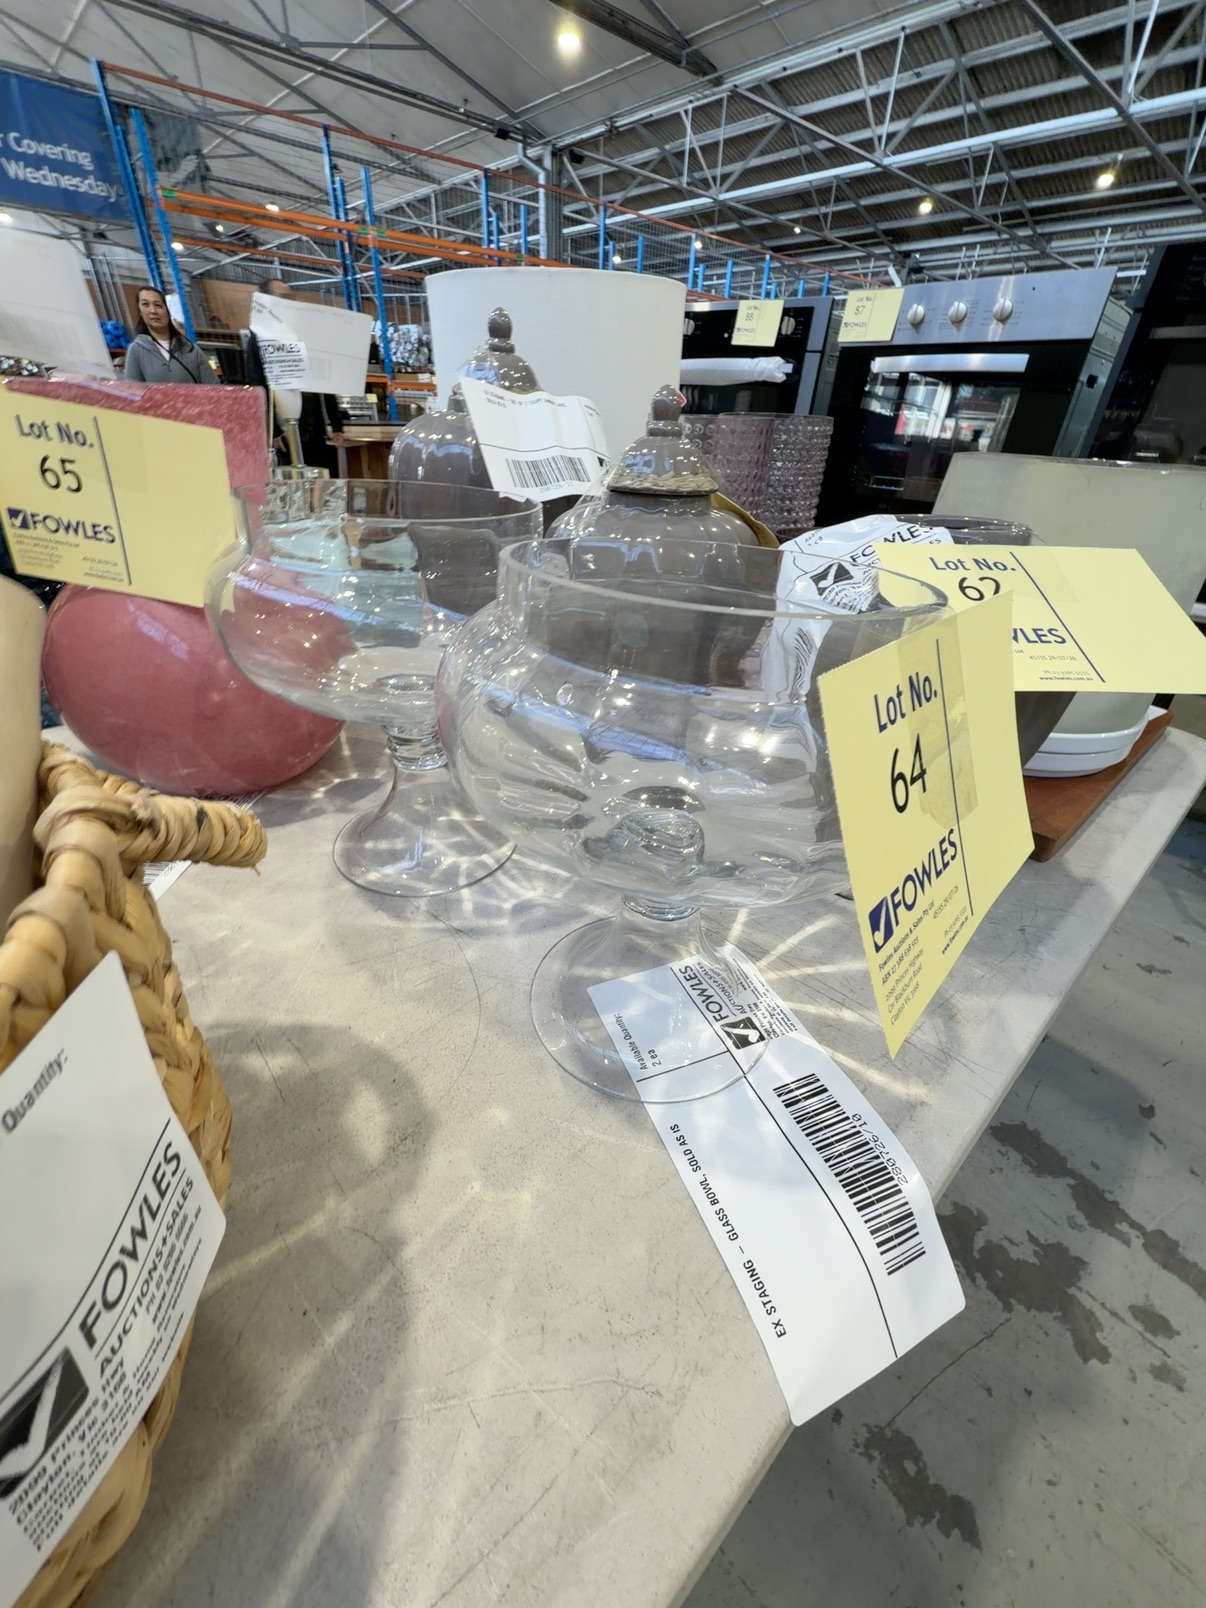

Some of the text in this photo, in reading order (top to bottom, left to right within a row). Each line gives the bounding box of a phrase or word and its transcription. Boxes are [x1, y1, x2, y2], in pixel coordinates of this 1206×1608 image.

[7, 132, 94, 170] Covering
[1, 158, 117, 202] Wednesday
[15, 414, 95, 449] Lot No.
[39, 454, 83, 494] 65
[30, 512, 117, 544] FOWLES
[929, 556, 1016, 572] Lot No.
[873, 671, 938, 733] Lot No.
[890, 733, 928, 814] 64
[890, 827, 958, 927] FOWLES
[679, 965, 729, 1022] FOWLES
[614, 1013, 648, 1070] Available Quantity:
[648, 1049, 658, 1059] ea
[1, 1048, 68, 1134] Quantity:
[669, 1123, 681, 1134] IS
[675, 1134, 688, 1147] AS
[851, 1113, 909, 1186] 280726/10
[683, 1148, 702, 1173] SOLD
[699, 1173, 720, 1206] BOWL,
[78, 1140, 182, 1351] FOWLES
[715, 1207, 739, 1242] GLASS
[100, 1177, 194, 1379] AUCTIONS+SALES
[152, 1205, 202, 1325] www.fowles.com.au
[743, 1259, 777, 1316] STAGING
[772, 1318, 787, 1339] EX
[51, 1398, 99, 1463] Princes
[101, 1356, 125, 1394] Hwy
